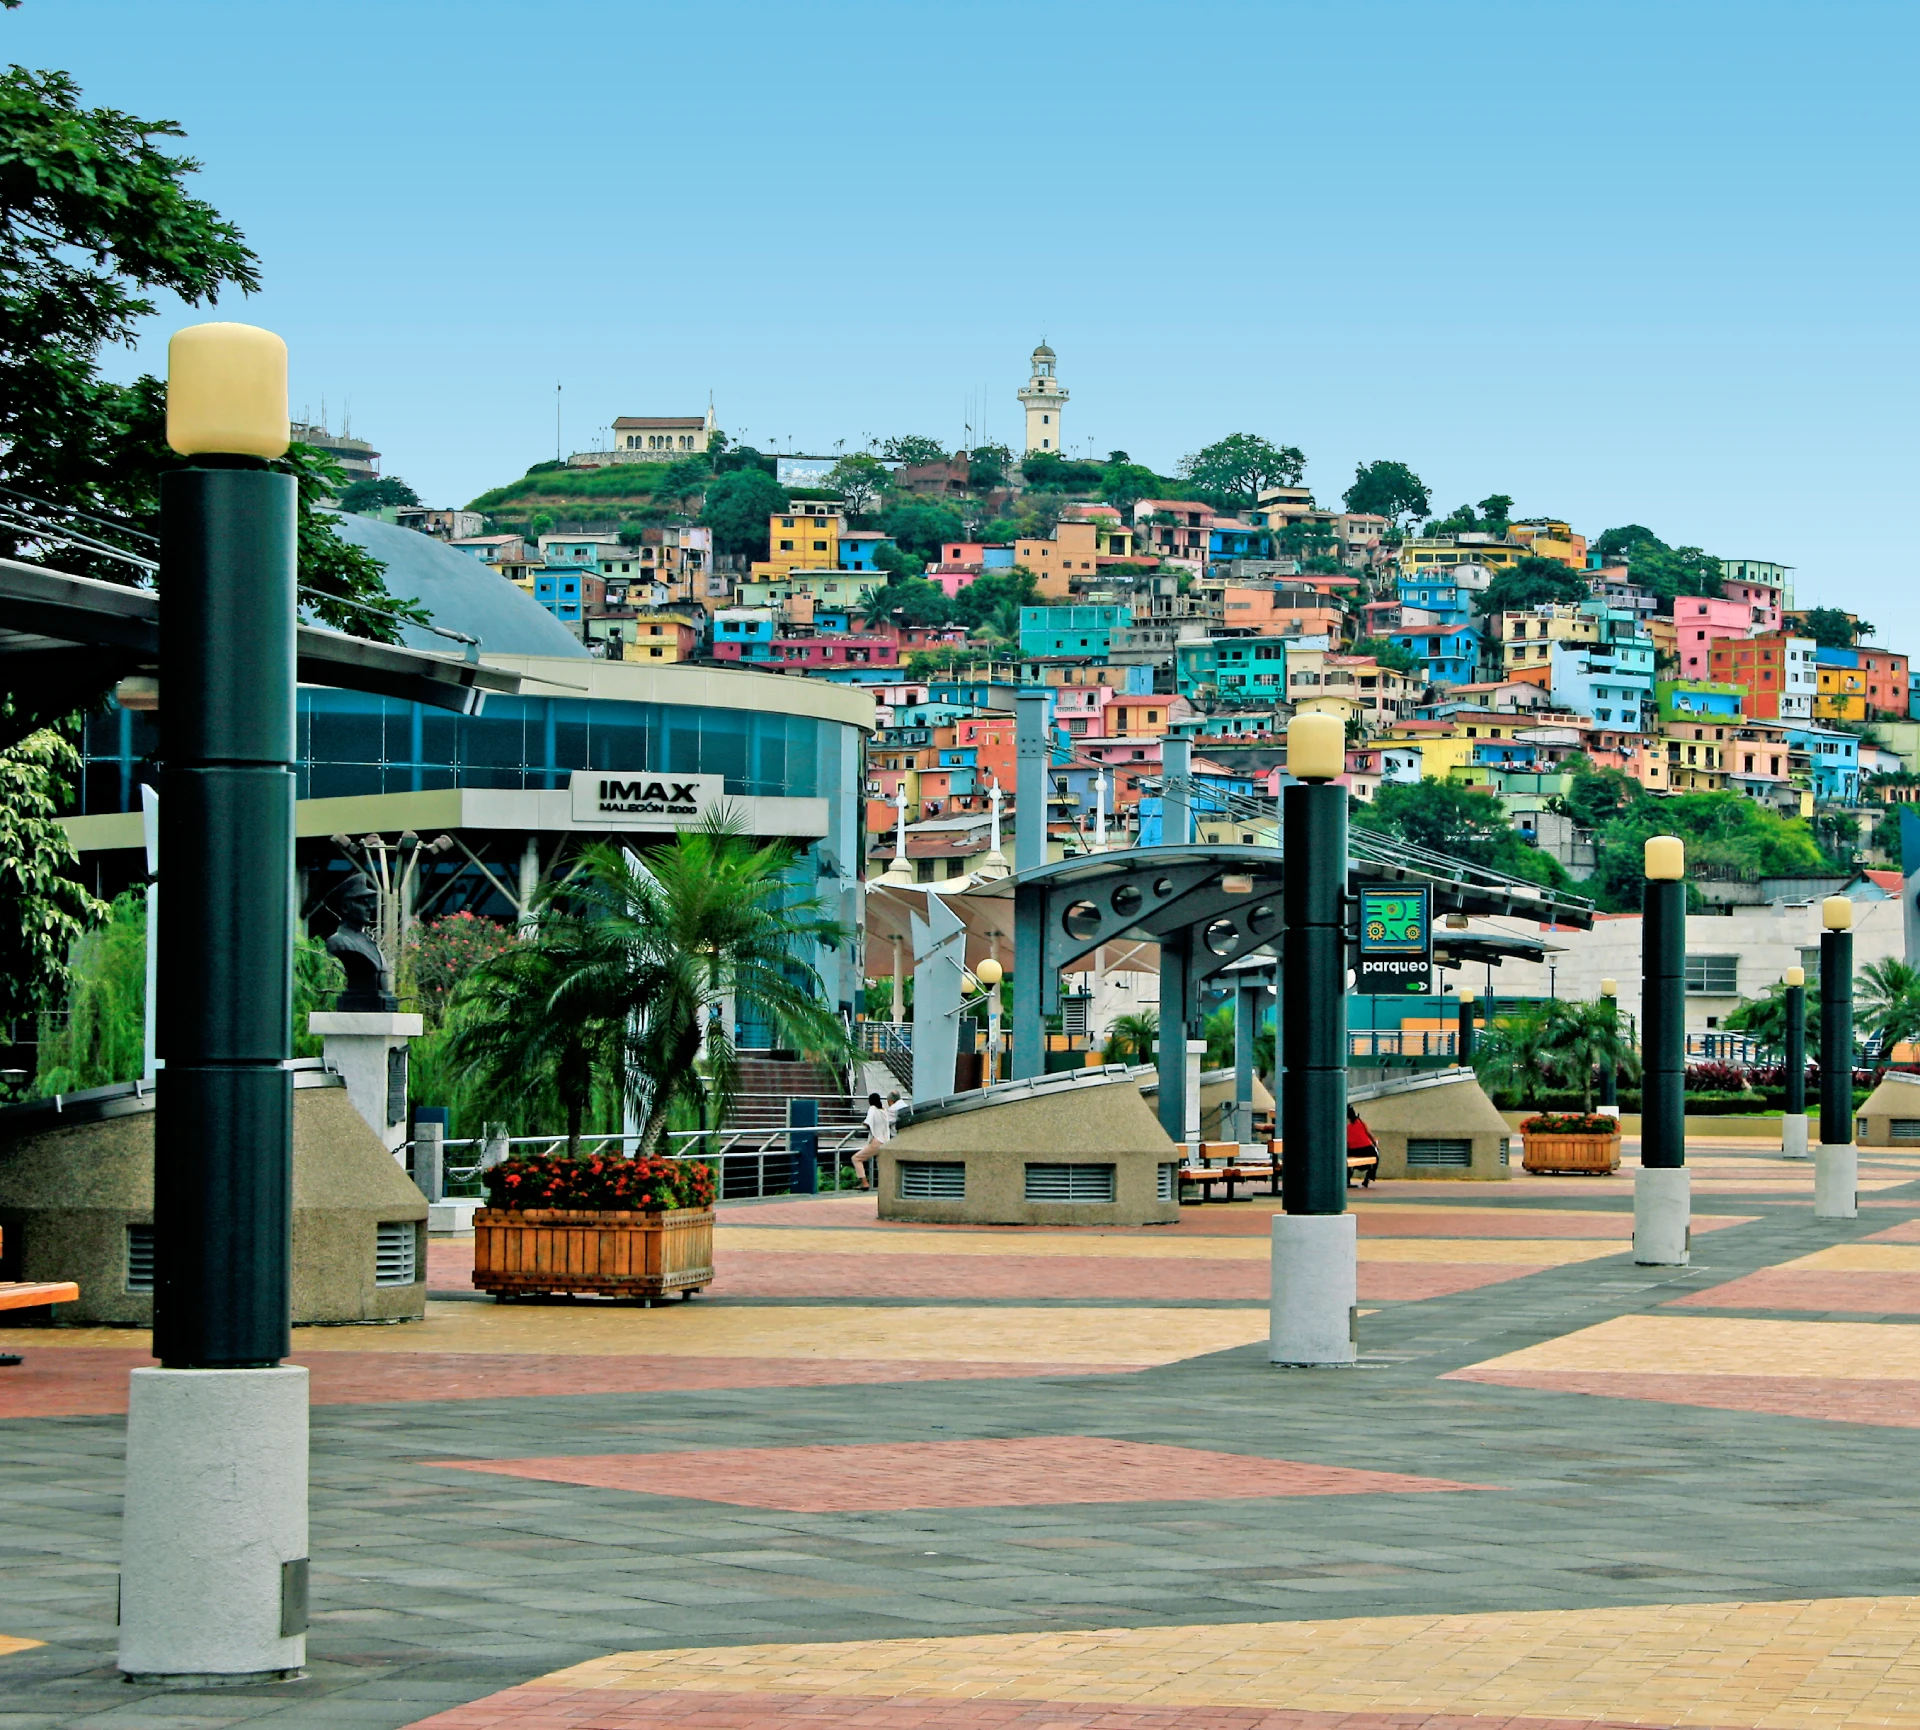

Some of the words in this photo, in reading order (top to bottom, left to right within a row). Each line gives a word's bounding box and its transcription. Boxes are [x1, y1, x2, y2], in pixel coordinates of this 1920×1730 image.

[600, 780, 697, 802] IMAX
[600, 802, 664, 813] MALECÓN
[666, 805, 697, 814] 2000
[1362, 961, 1429, 975] parqueo
